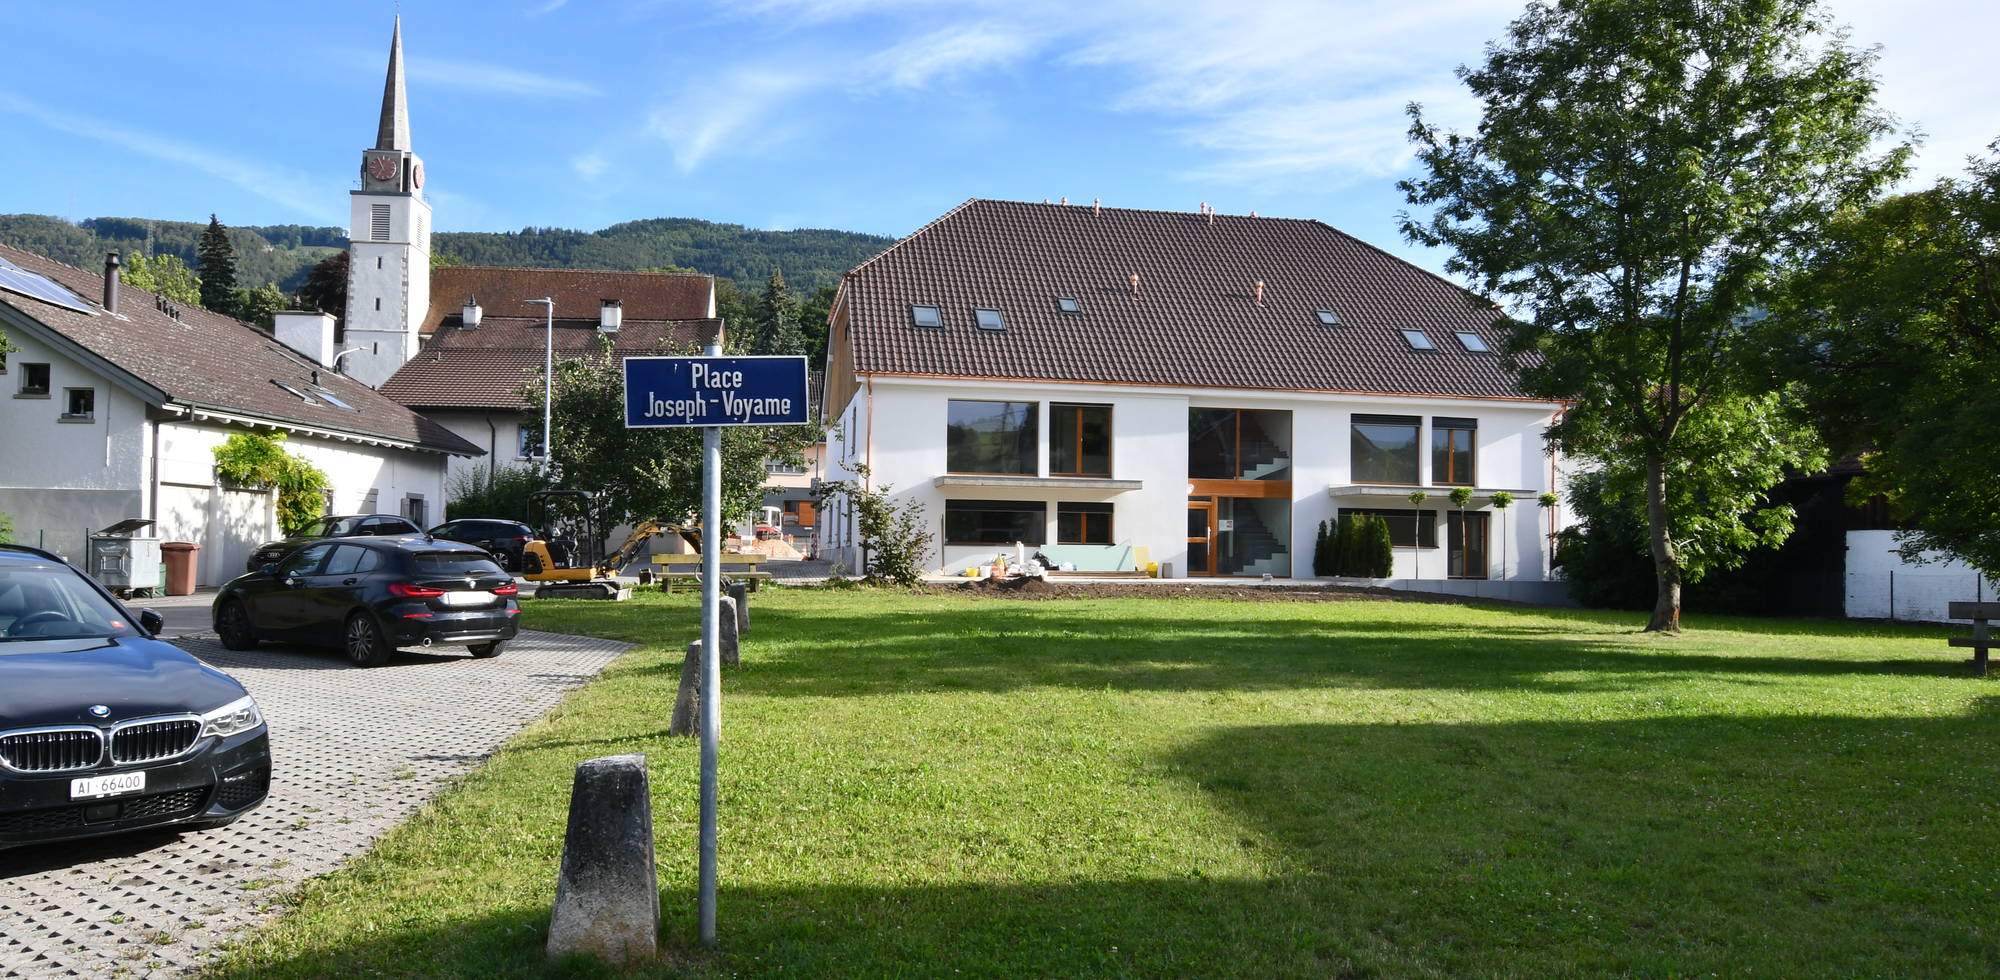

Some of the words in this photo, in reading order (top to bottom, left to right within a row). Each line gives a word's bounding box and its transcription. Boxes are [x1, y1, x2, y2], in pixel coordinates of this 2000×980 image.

[691, 363, 743, 389] Place
[78, 781, 90, 795] AI
[101, 775, 141, 792] 66400
